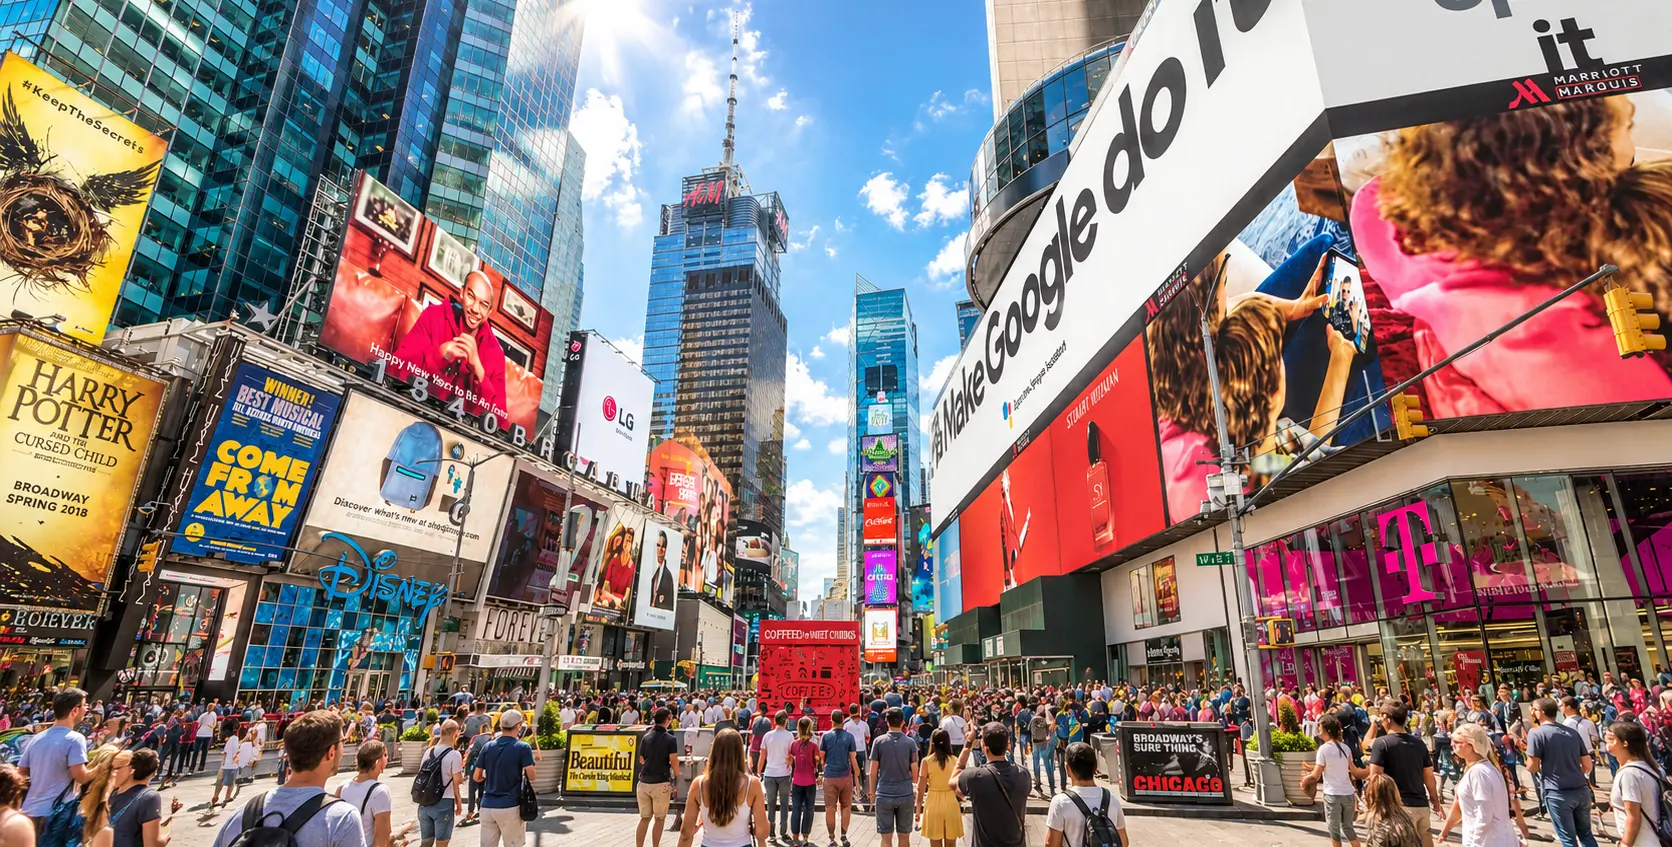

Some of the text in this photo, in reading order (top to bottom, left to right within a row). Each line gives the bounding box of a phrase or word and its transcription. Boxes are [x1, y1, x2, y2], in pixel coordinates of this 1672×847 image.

[1532, 17, 1606, 74] it
[1553, 63, 1642, 85] MARRIOTT
[1557, 77, 1640, 98] MARQUIS
[21, 79, 145, 155] #KeepTheSecrets
[1103, 56, 1187, 215] do
[984, 188, 1099, 386] Google
[26, 358, 145, 419] HARRY
[369, 342, 405, 370] Happy
[406, 361, 431, 380] New
[454, 385, 464, 398] to
[235, 384, 272, 411] BEST
[269, 397, 325, 431] MUSICAL
[263, 376, 316, 409] WINNER!
[943, 360, 985, 453] Make
[7, 385, 137, 452] POTTER
[618, 407, 635, 431] LG
[14, 431, 71, 456] CURSED
[74, 446, 118, 468] CHILD
[216, 439, 311, 484] COME
[6, 493, 89, 518] SPRING 2018
[13, 481, 90, 505] BROADWAY
[193, 489, 294, 529] AWAY
[333, 496, 373, 514] Discover
[483, 607, 551, 644] FOREVE
[1132, 733, 1204, 744] BROADWAY'S
[1163, 743, 1198, 753] THING
[569, 750, 633, 771] Beautiful
[1133, 775, 1224, 793] CHICAGO
